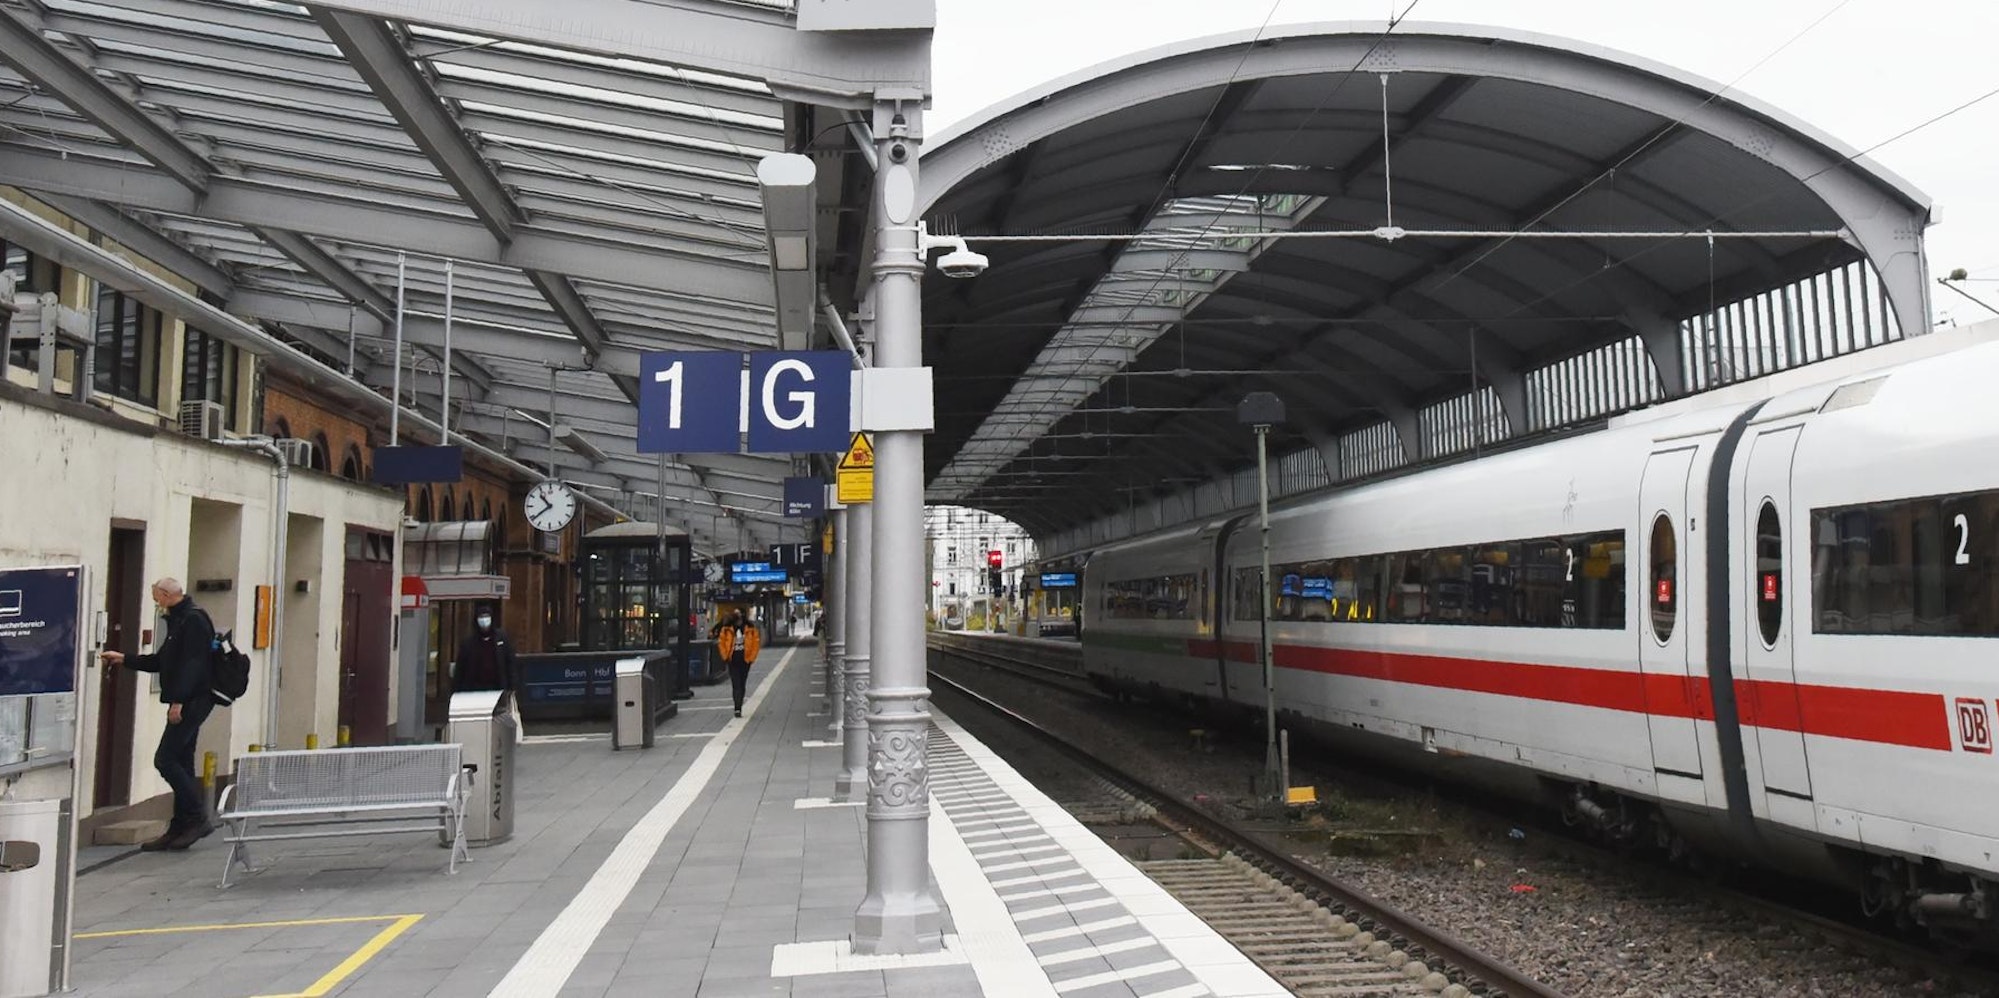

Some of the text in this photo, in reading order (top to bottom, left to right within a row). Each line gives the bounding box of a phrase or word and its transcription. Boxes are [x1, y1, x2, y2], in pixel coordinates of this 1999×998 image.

[655, 359, 815, 430] 1 G
[773, 545, 811, 564] 1 F
[1954, 514, 1969, 564] 2
[1566, 548, 1573, 581] 2
[565, 667, 610, 678] Bonn Hbf
[1960, 706, 1987, 745] DB
[494, 755, 502, 820] Abfall
